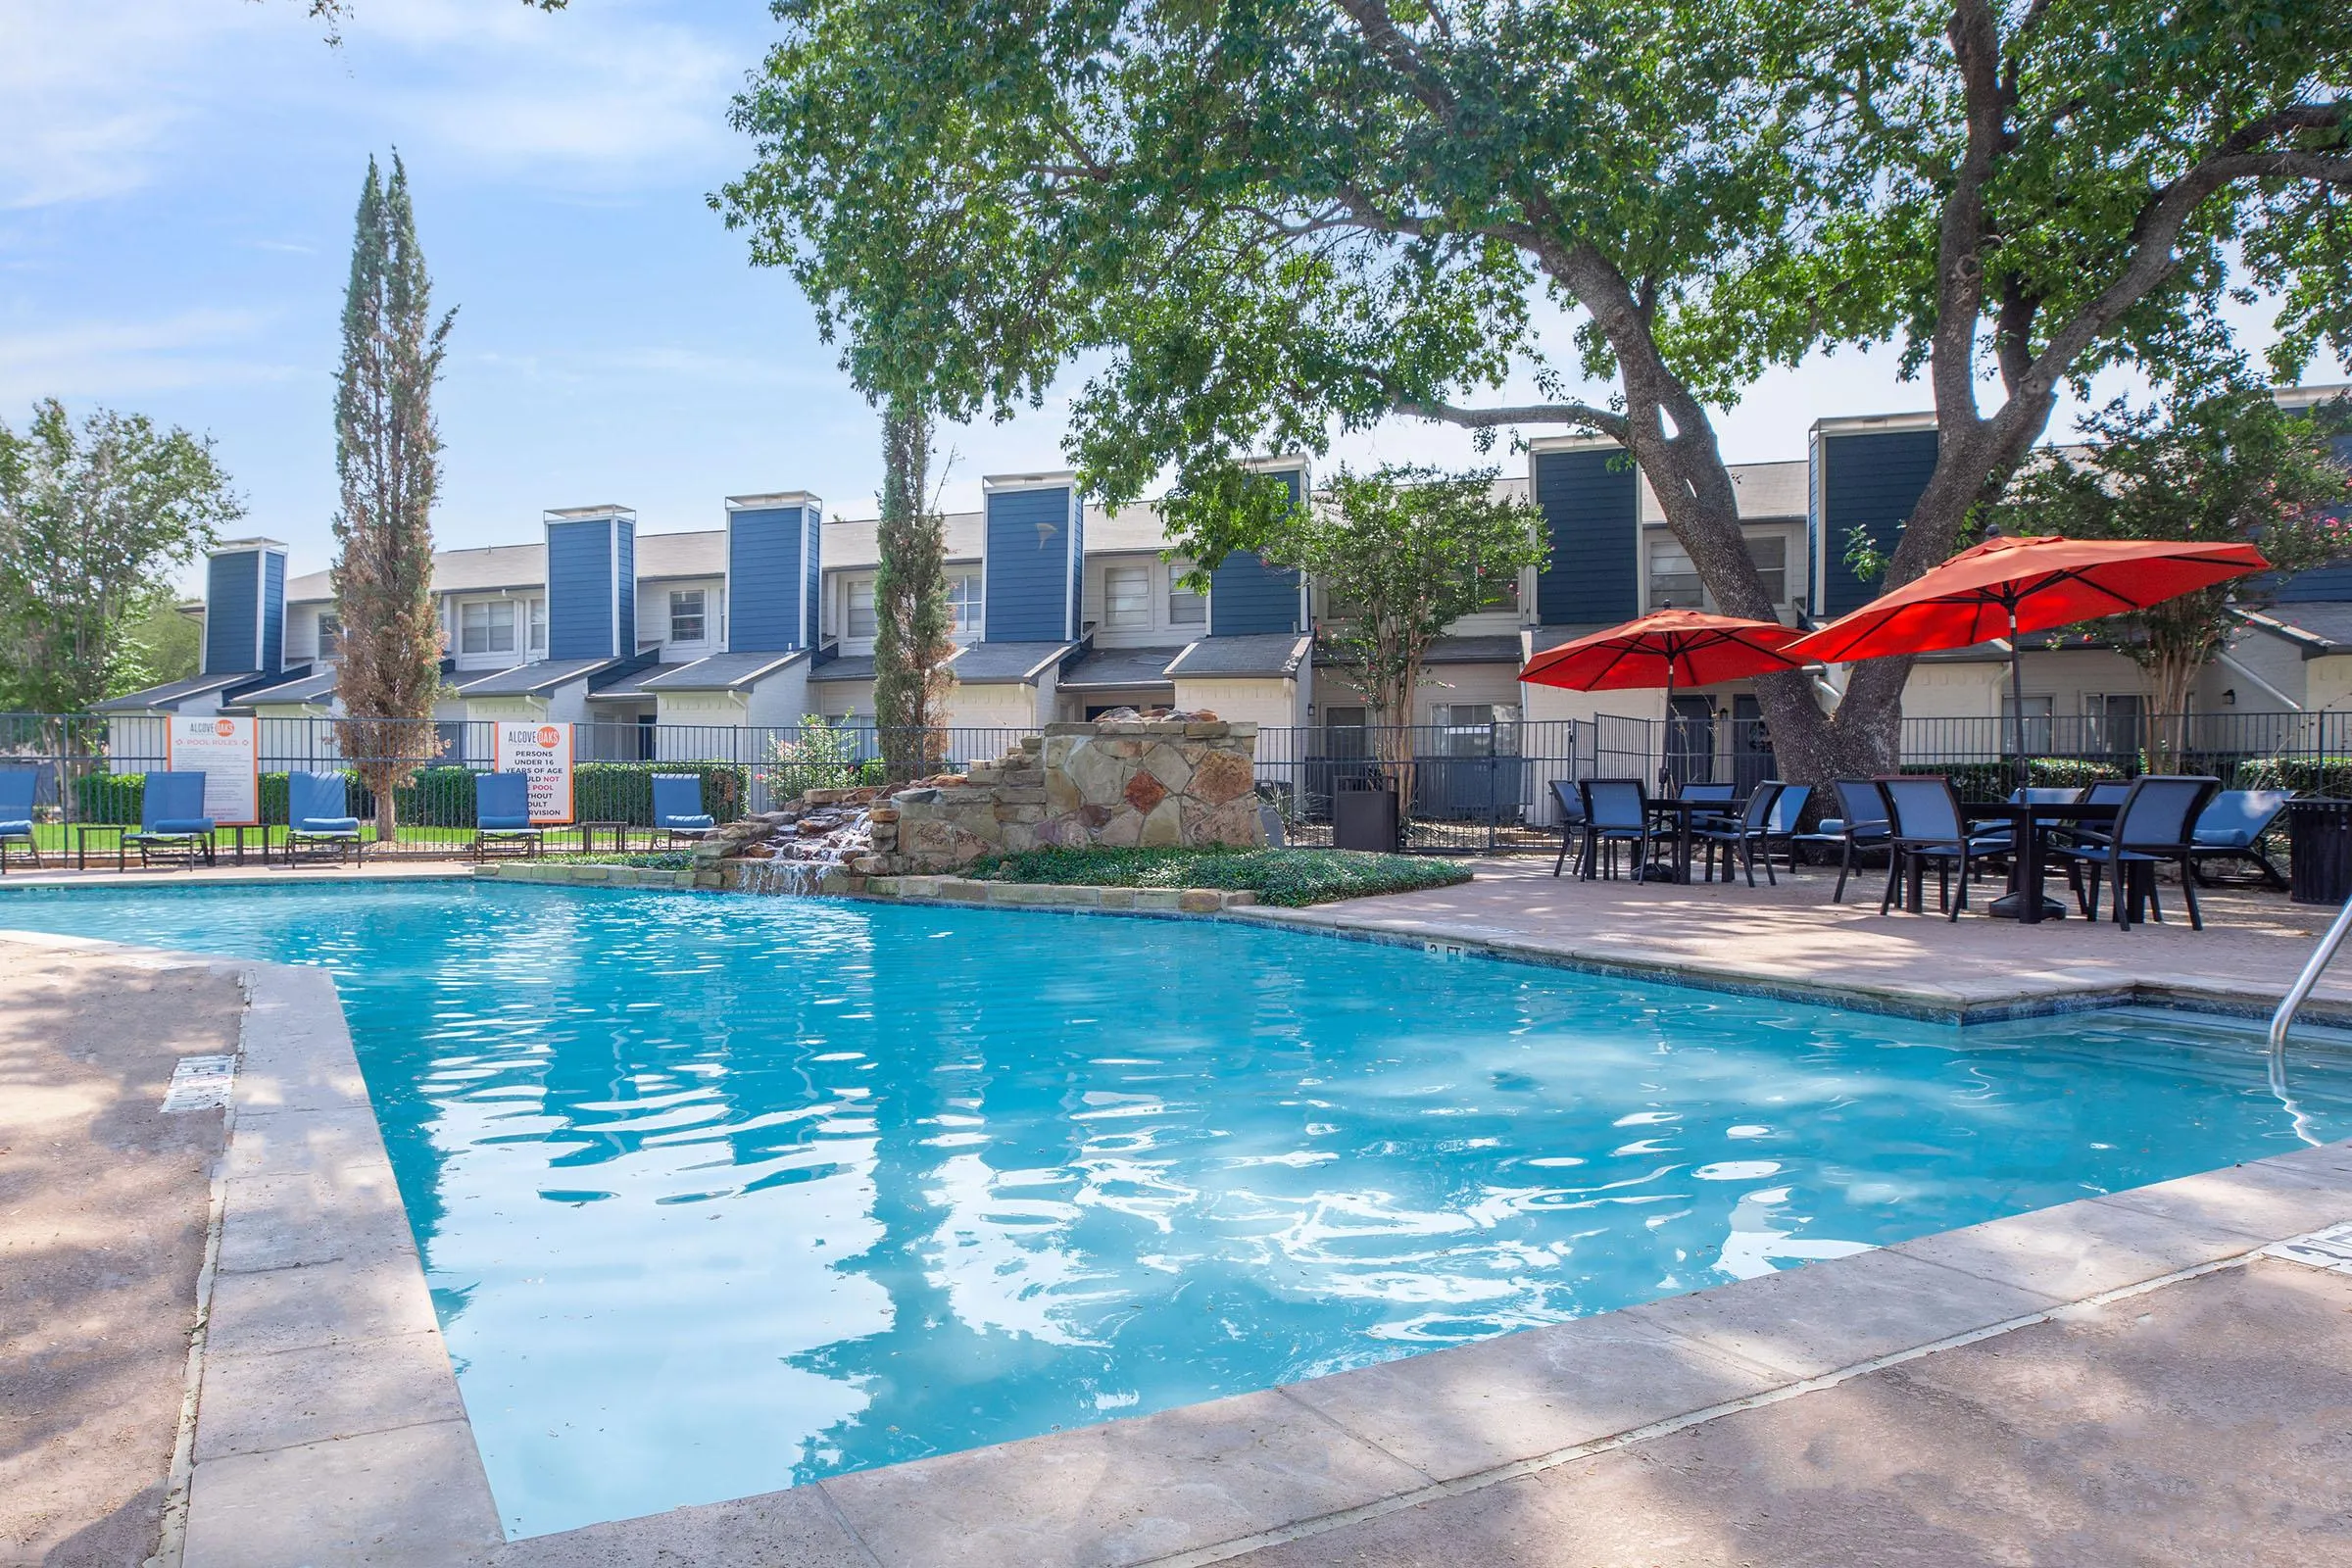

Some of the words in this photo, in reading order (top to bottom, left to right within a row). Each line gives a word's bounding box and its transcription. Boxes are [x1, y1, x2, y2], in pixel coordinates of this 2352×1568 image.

[190, 722, 214, 733] ALCOVE
[215, 723, 234, 733] OAKS
[508, 731, 537, 743] ALCOVE
[538, 731, 559, 744] OAKS
